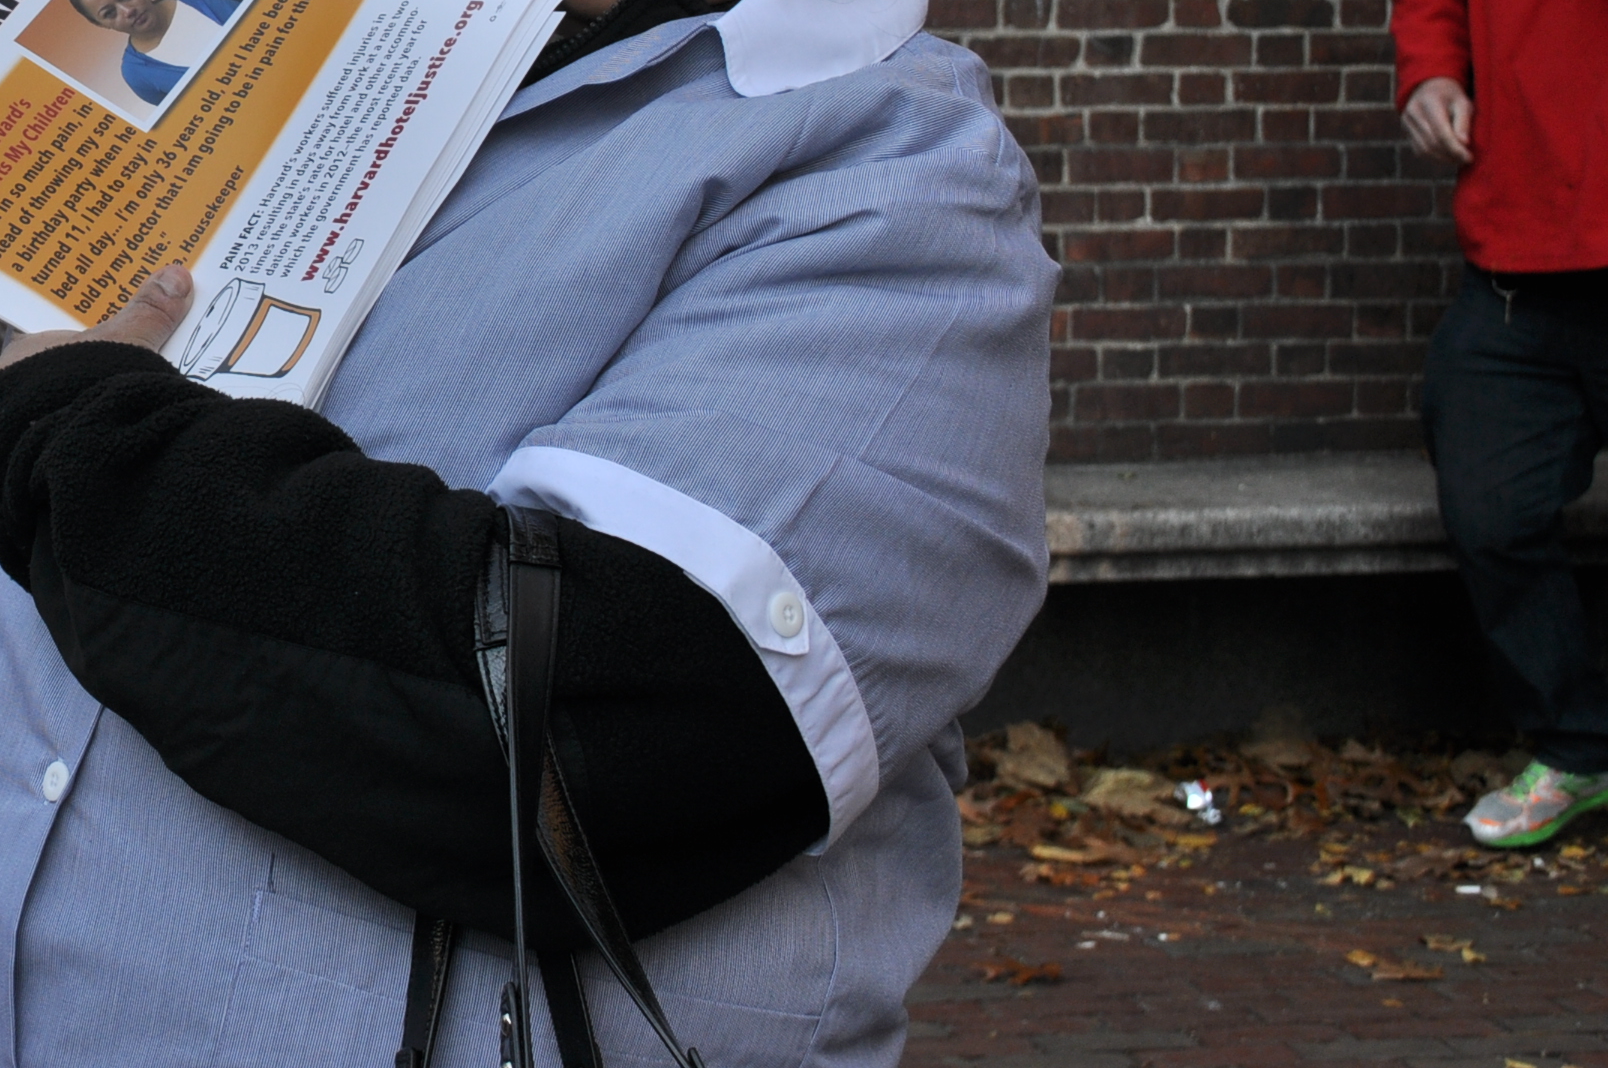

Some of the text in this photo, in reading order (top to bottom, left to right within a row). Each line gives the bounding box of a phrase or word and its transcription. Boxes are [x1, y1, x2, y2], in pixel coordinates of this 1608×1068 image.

[238, 21, 271, 53] have
[276, 14, 298, 35] for
[233, 53, 248, 61] I
[259, 36, 286, 67] pain
[215, 62, 242, 86] but
[244, 66, 265, 81] in
[200, 89, 226, 113] old,
[231, 81, 254, 99] be
[223, 100, 241, 114] to
[3, 140, 33, 164] My
[22, 87, 76, 142] Children
[172, 114, 204, 152] years
[198, 115, 234, 155] going
[234, 0, 410, 272] 2013 resulting in days away from work at a rate two
[249, 6, 419, 274] times the state's rate for hotel and other accommo-
[301, 0, 484, 282] www.harvardhoteljustice.org
[9, 182, 27, 199] so
[22, 149, 56, 183] much
[50, 121, 83, 153] pain,
[72, 101, 93, 119] in-
[219, 13, 387, 270] PAIN FACT: Harvard's workers suffered injuries in
[265, 240, 293, 276] dation
[289, 195, 321, 238] workers
[314, 181, 329, 193] in
[359, 97, 381, 124] most
[377, 62, 403, 95] recent
[398, 36, 417, 60] year
[411, 19, 428, 35] for
[18, 207, 35, 225] of
[28, 156, 84, 211] throwing
[75, 135, 100, 158] my
[92, 113, 117, 137] son
[155, 150, 177, 169] 36
[182, 154, 204, 176] am
[280, 56, 422, 278] which the government has reported data.
[135, 169, 165, 200] only
[173, 174, 188, 183] I
[11, 126, 137, 273] a birthday party when he
[30, 138, 158, 285] turned 11, I had to stay in
[114, 200, 141, 222] I'm
[154, 182, 183, 210] that
[179, 164, 244, 254] Housekeeper
[88, 225, 123, 257] day...
[125, 209, 162, 251] doctor
[74, 253, 94, 275] all
[109, 249, 134, 273] my
[50, 271, 80, 300] bed
[93, 269, 117, 289] by
[117, 284, 133, 304] of
[128, 265, 152, 289] my
[73, 284, 102, 314] told
